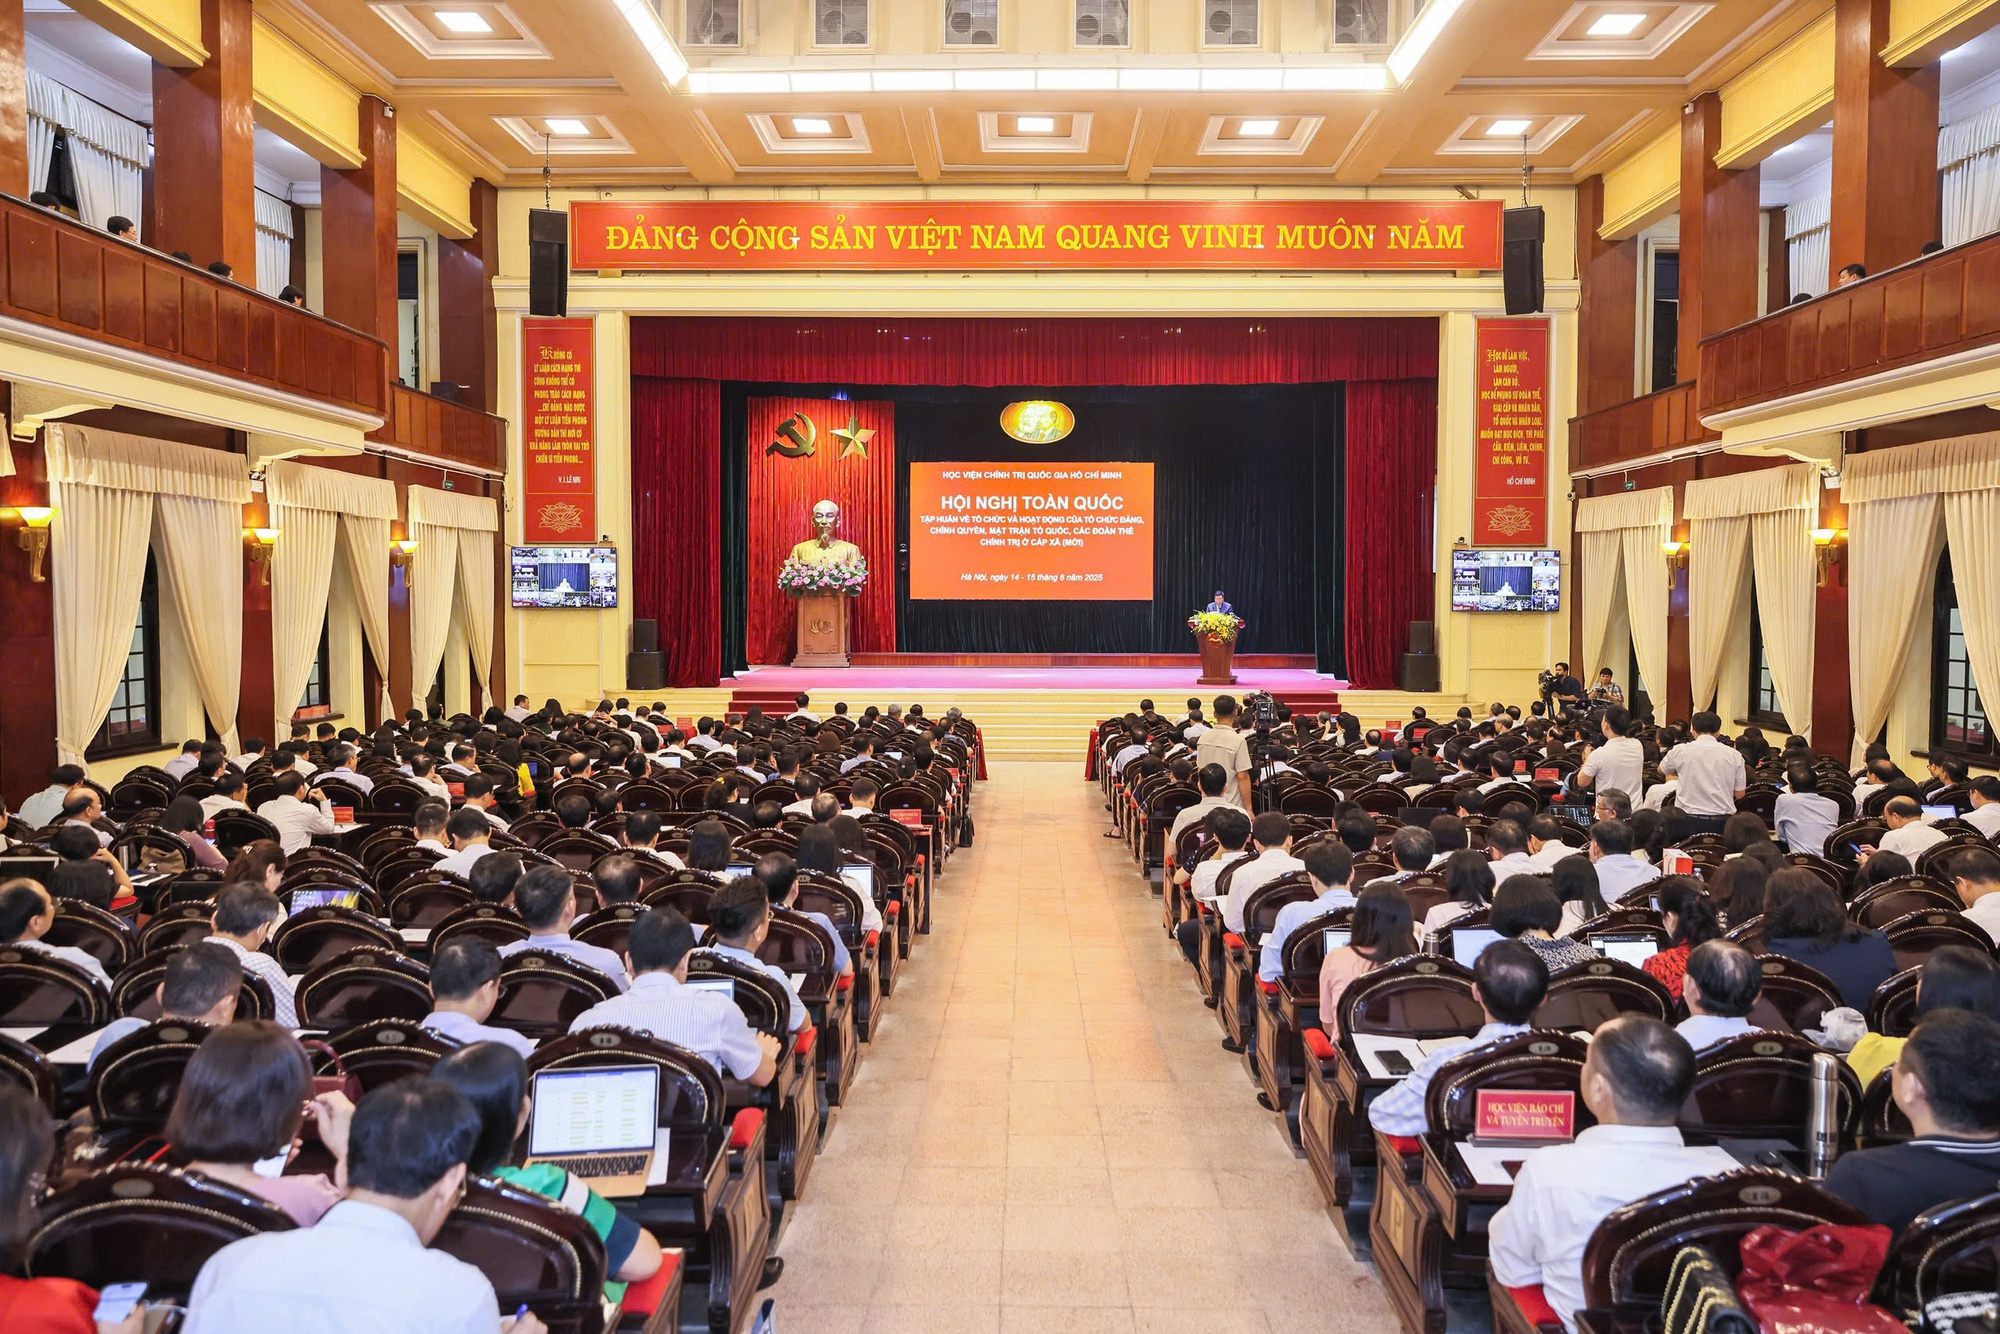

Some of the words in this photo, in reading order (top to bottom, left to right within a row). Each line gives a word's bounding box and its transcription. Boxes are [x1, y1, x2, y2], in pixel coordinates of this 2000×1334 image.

[605, 213, 700, 250] ĐẢNG
[710, 217, 801, 257] CỘNG
[810, 212, 877, 250] SẢN
[884, 217, 962, 256] VIỆT
[970, 224, 1046, 249] NAM
[1055, 224, 1171, 251] QUANG
[1178, 223, 1265, 249] VINH
[1275, 216, 1377, 249] MUÔN
[1387, 217, 1465, 249] NĂM
[942, 471, 961, 480] HỌC
[962, 470, 983, 480] VIỆN
[983, 470, 1010, 479] CHÍNH
[1011, 471, 1026, 480] TRỊ
[1026, 469, 1052, 479] QUỐC
[1053, 471, 1069, 479] GIA
[1069, 470, 1083, 479] HỒ
[1084, 470, 1100, 479] CHÍ
[1100, 471, 1122, 479] MINH
[1524, 477, 1536, 485] MINH
[941, 493, 971, 513] HỘI
[975, 495, 1018, 513] NGHỊ
[1021, 493, 1069, 510] TOÀN
[1073, 492, 1124, 511] QUỐC
[960, 573, 973, 581] Hà
[973, 573, 989, 582] Nội,
[989, 573, 1009, 583] ngày
[1010, 573, 1020, 581] 14
[1026, 573, 1036, 581] 15
[1036, 573, 1059, 583] tháng
[1059, 573, 1065, 581] 6
[1066, 573, 1083, 582] năm
[1083, 573, 1104, 582] 2025
[1487, 1102, 1506, 1113] HỌC
[1507, 1102, 1528, 1114] VIỆN
[1529, 1101, 1547, 1113] BÁO
[1548, 1101, 1565, 1113] CHÍ
[1486, 1113, 1499, 1125] VÀ
[1530, 1115, 1565, 1127] TRUYỀN
